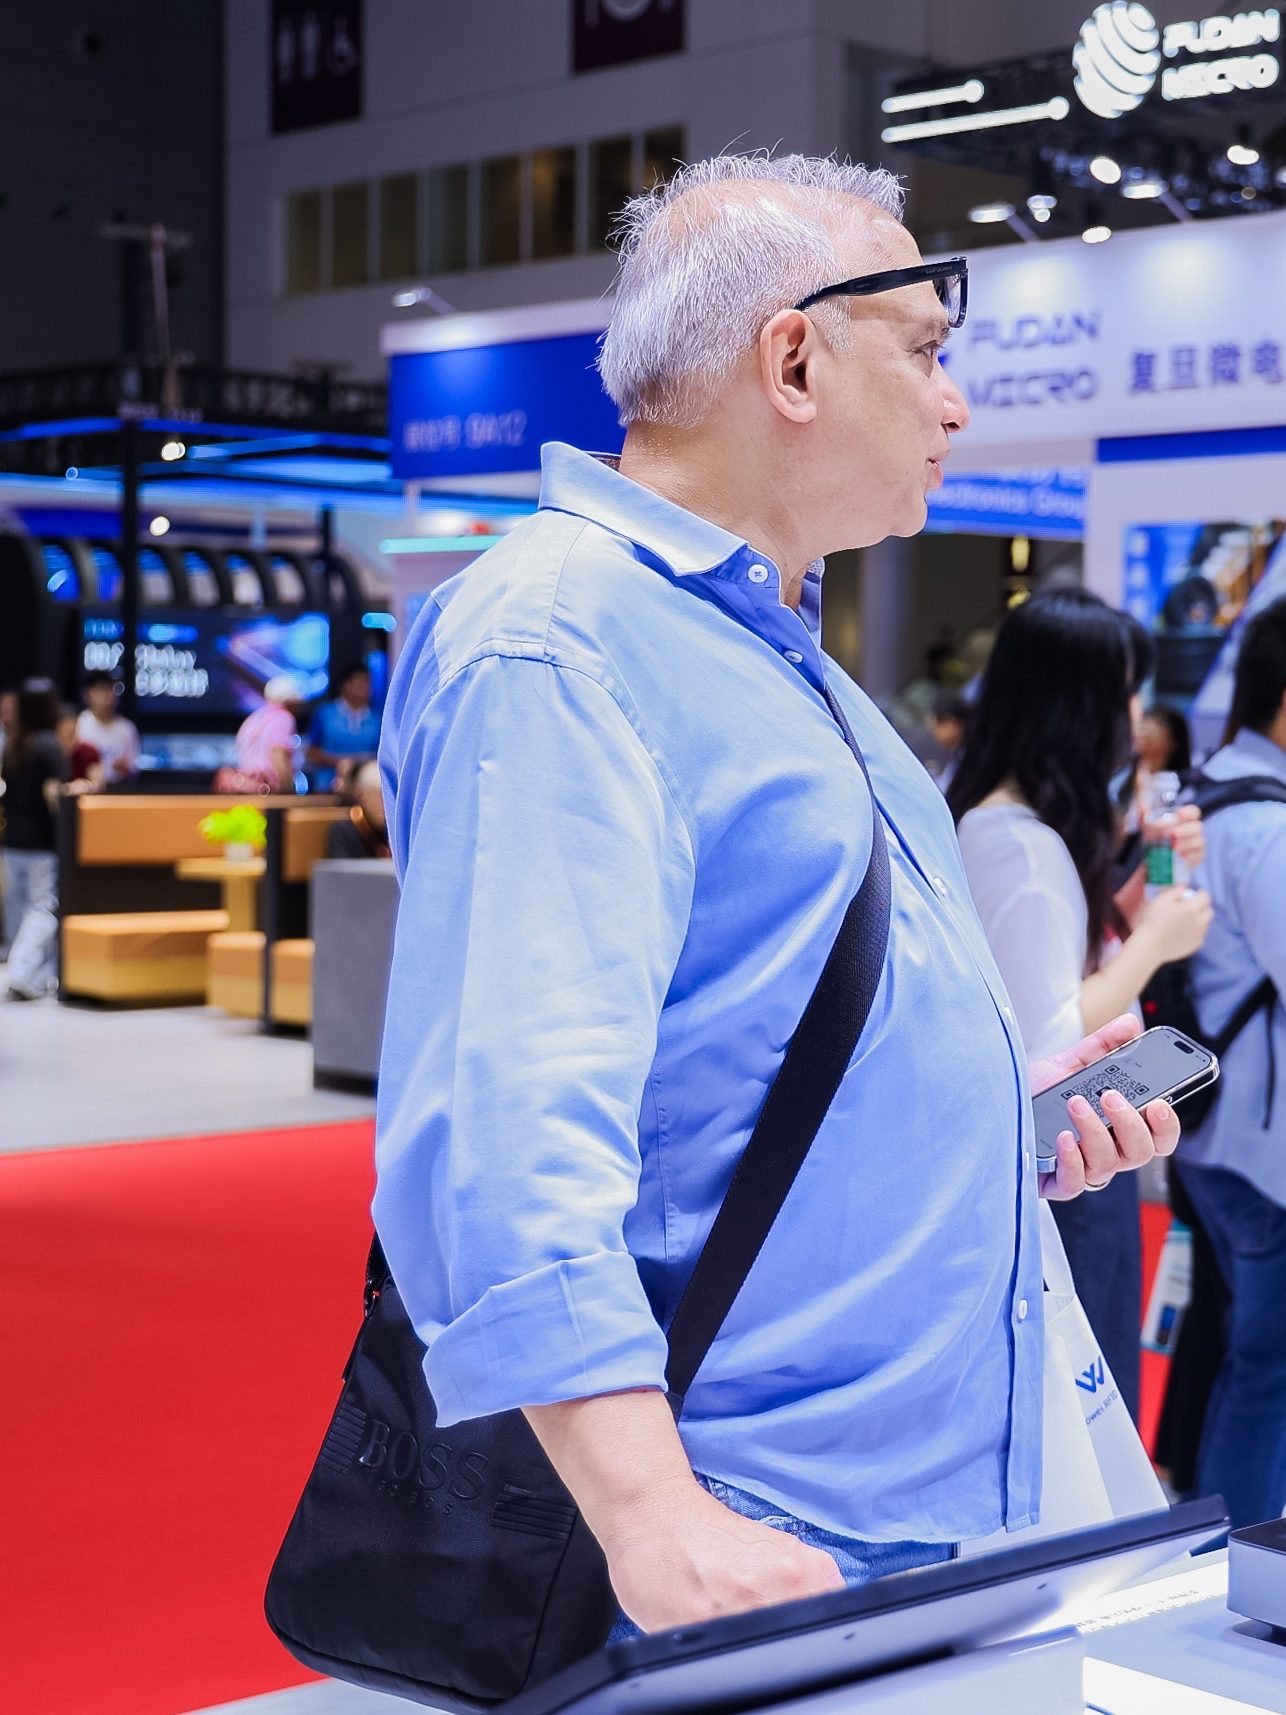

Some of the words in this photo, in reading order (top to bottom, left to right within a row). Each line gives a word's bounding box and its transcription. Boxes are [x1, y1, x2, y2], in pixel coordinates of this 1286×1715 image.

[968, 310, 1100, 353] FUDAN
[966, 366, 1096, 408] MICRO
[359, 1418, 489, 1500] BOSS
